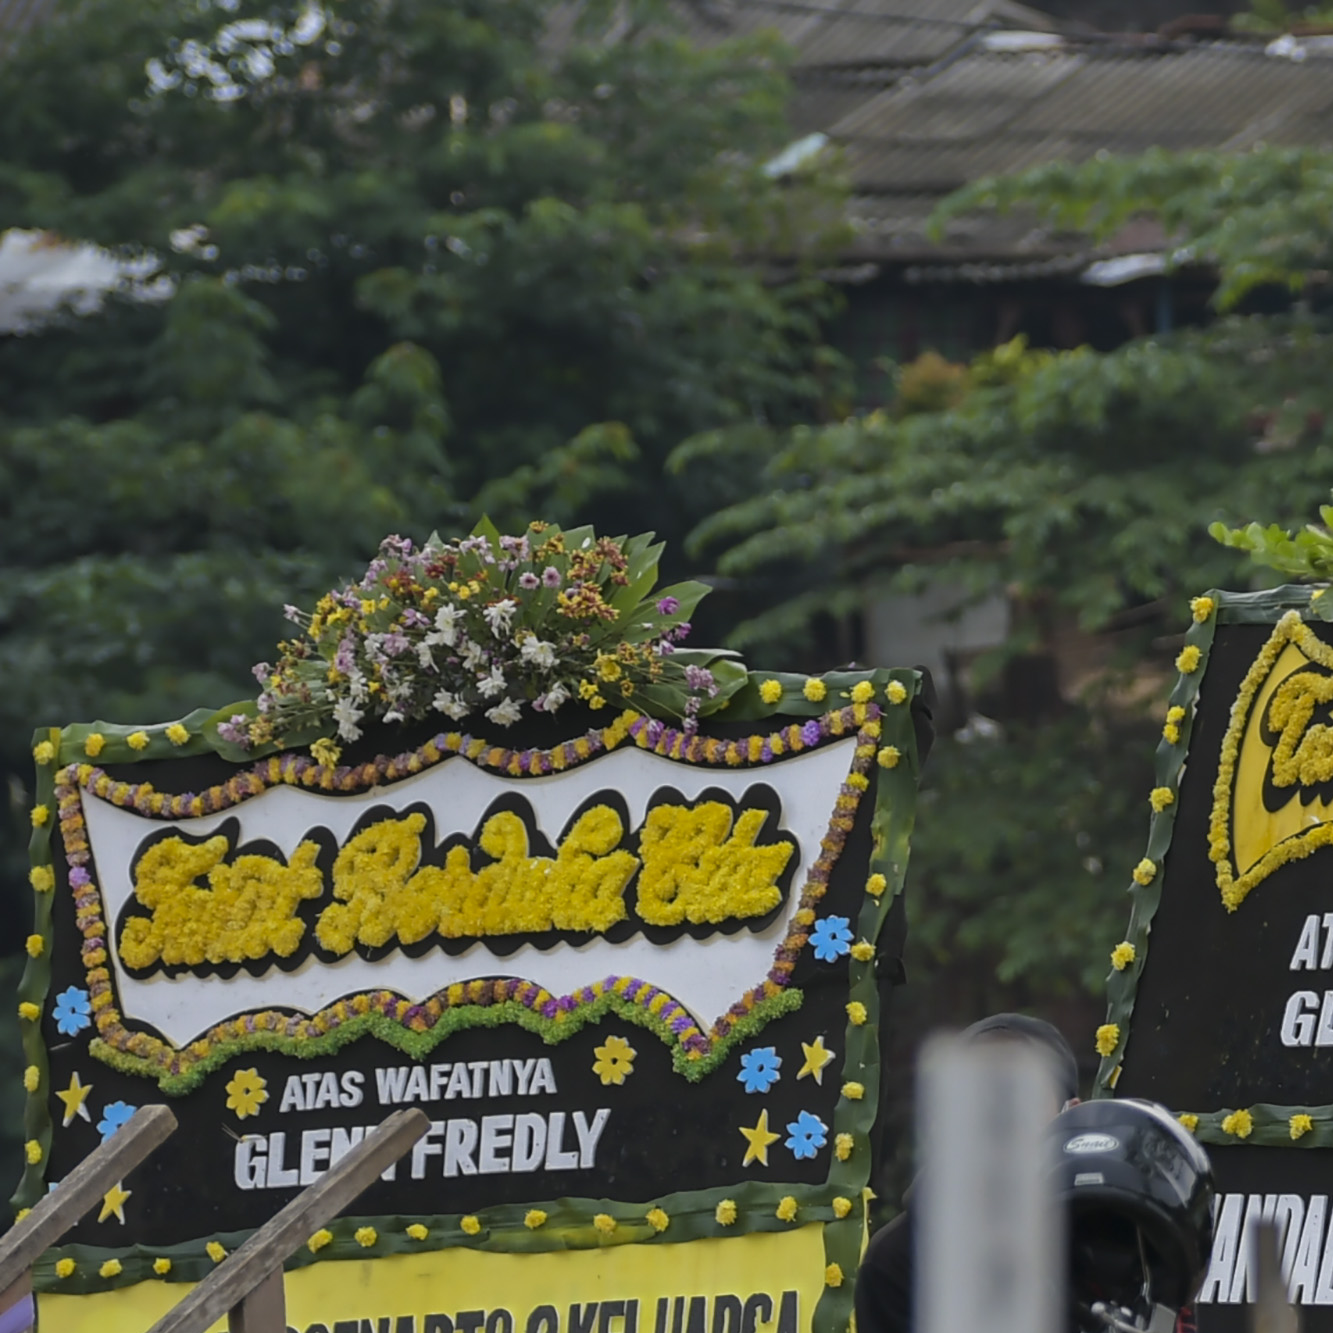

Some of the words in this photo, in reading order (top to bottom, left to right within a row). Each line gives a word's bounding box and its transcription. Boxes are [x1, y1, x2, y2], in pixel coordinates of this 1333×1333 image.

[280, 1070, 365, 1113] ATAS
[375, 1058, 557, 1105] WAFATNYA
[411, 1109, 611, 1180] FREDLY
